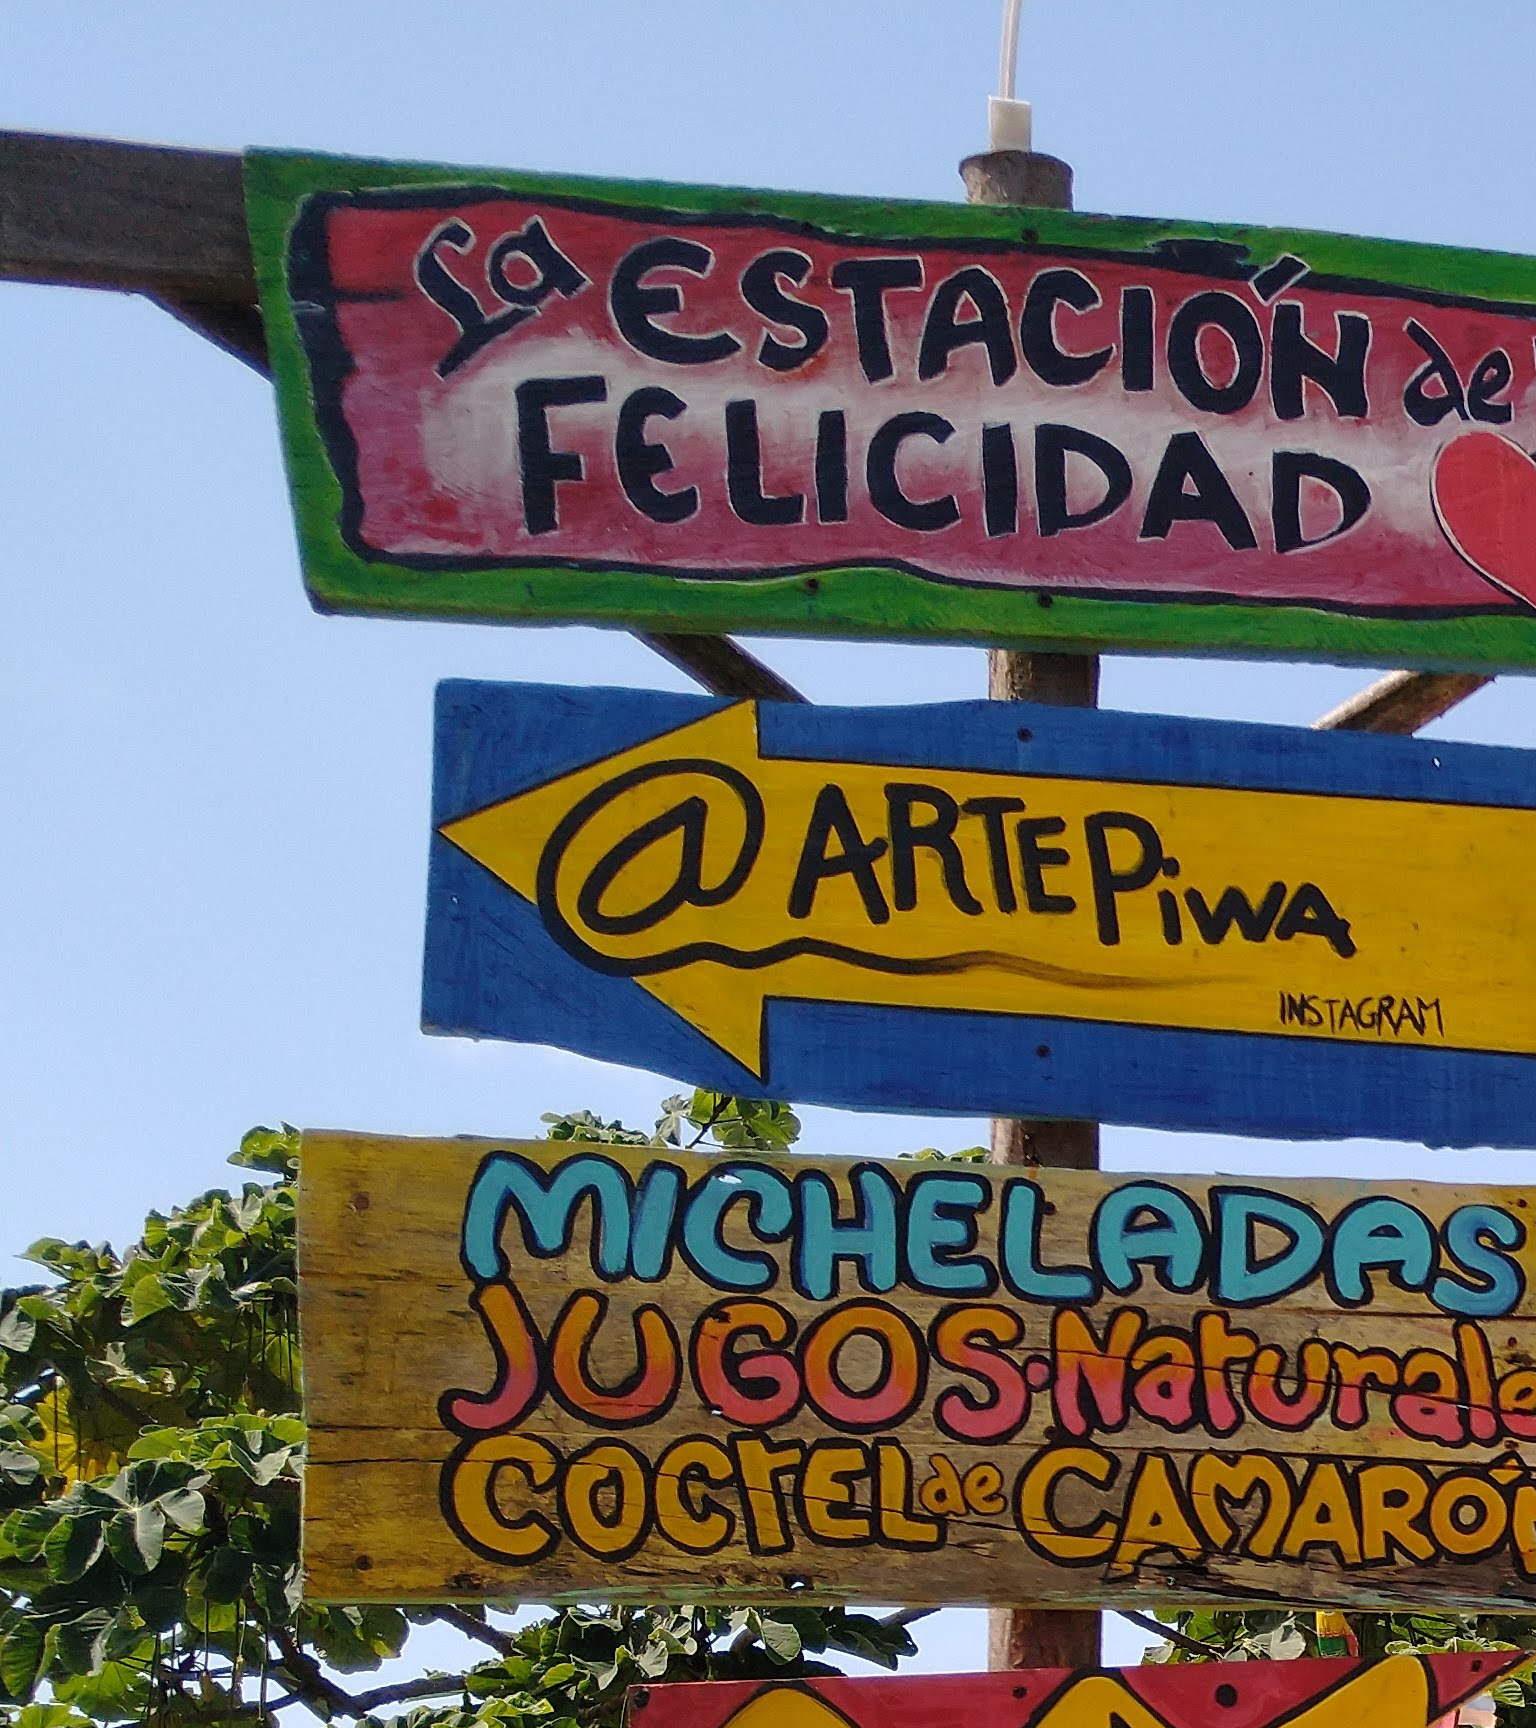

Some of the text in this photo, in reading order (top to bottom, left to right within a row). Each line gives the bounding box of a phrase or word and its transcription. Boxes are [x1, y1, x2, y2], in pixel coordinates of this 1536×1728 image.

[410, 216, 590, 374] La
[608, 237, 1380, 421] ESTACIÓN
[1403, 317, 1513, 427] de
[515, 374, 1373, 555] FELICIDAD
[1276, 990, 1446, 1038] INSTAGRAM
[461, 1150, 1530, 1318] MICHELADAS
[437, 1278, 1032, 1444] JUGOS
[439, 1430, 948, 1566] COCTEL
[920, 1453, 1008, 1518] de
